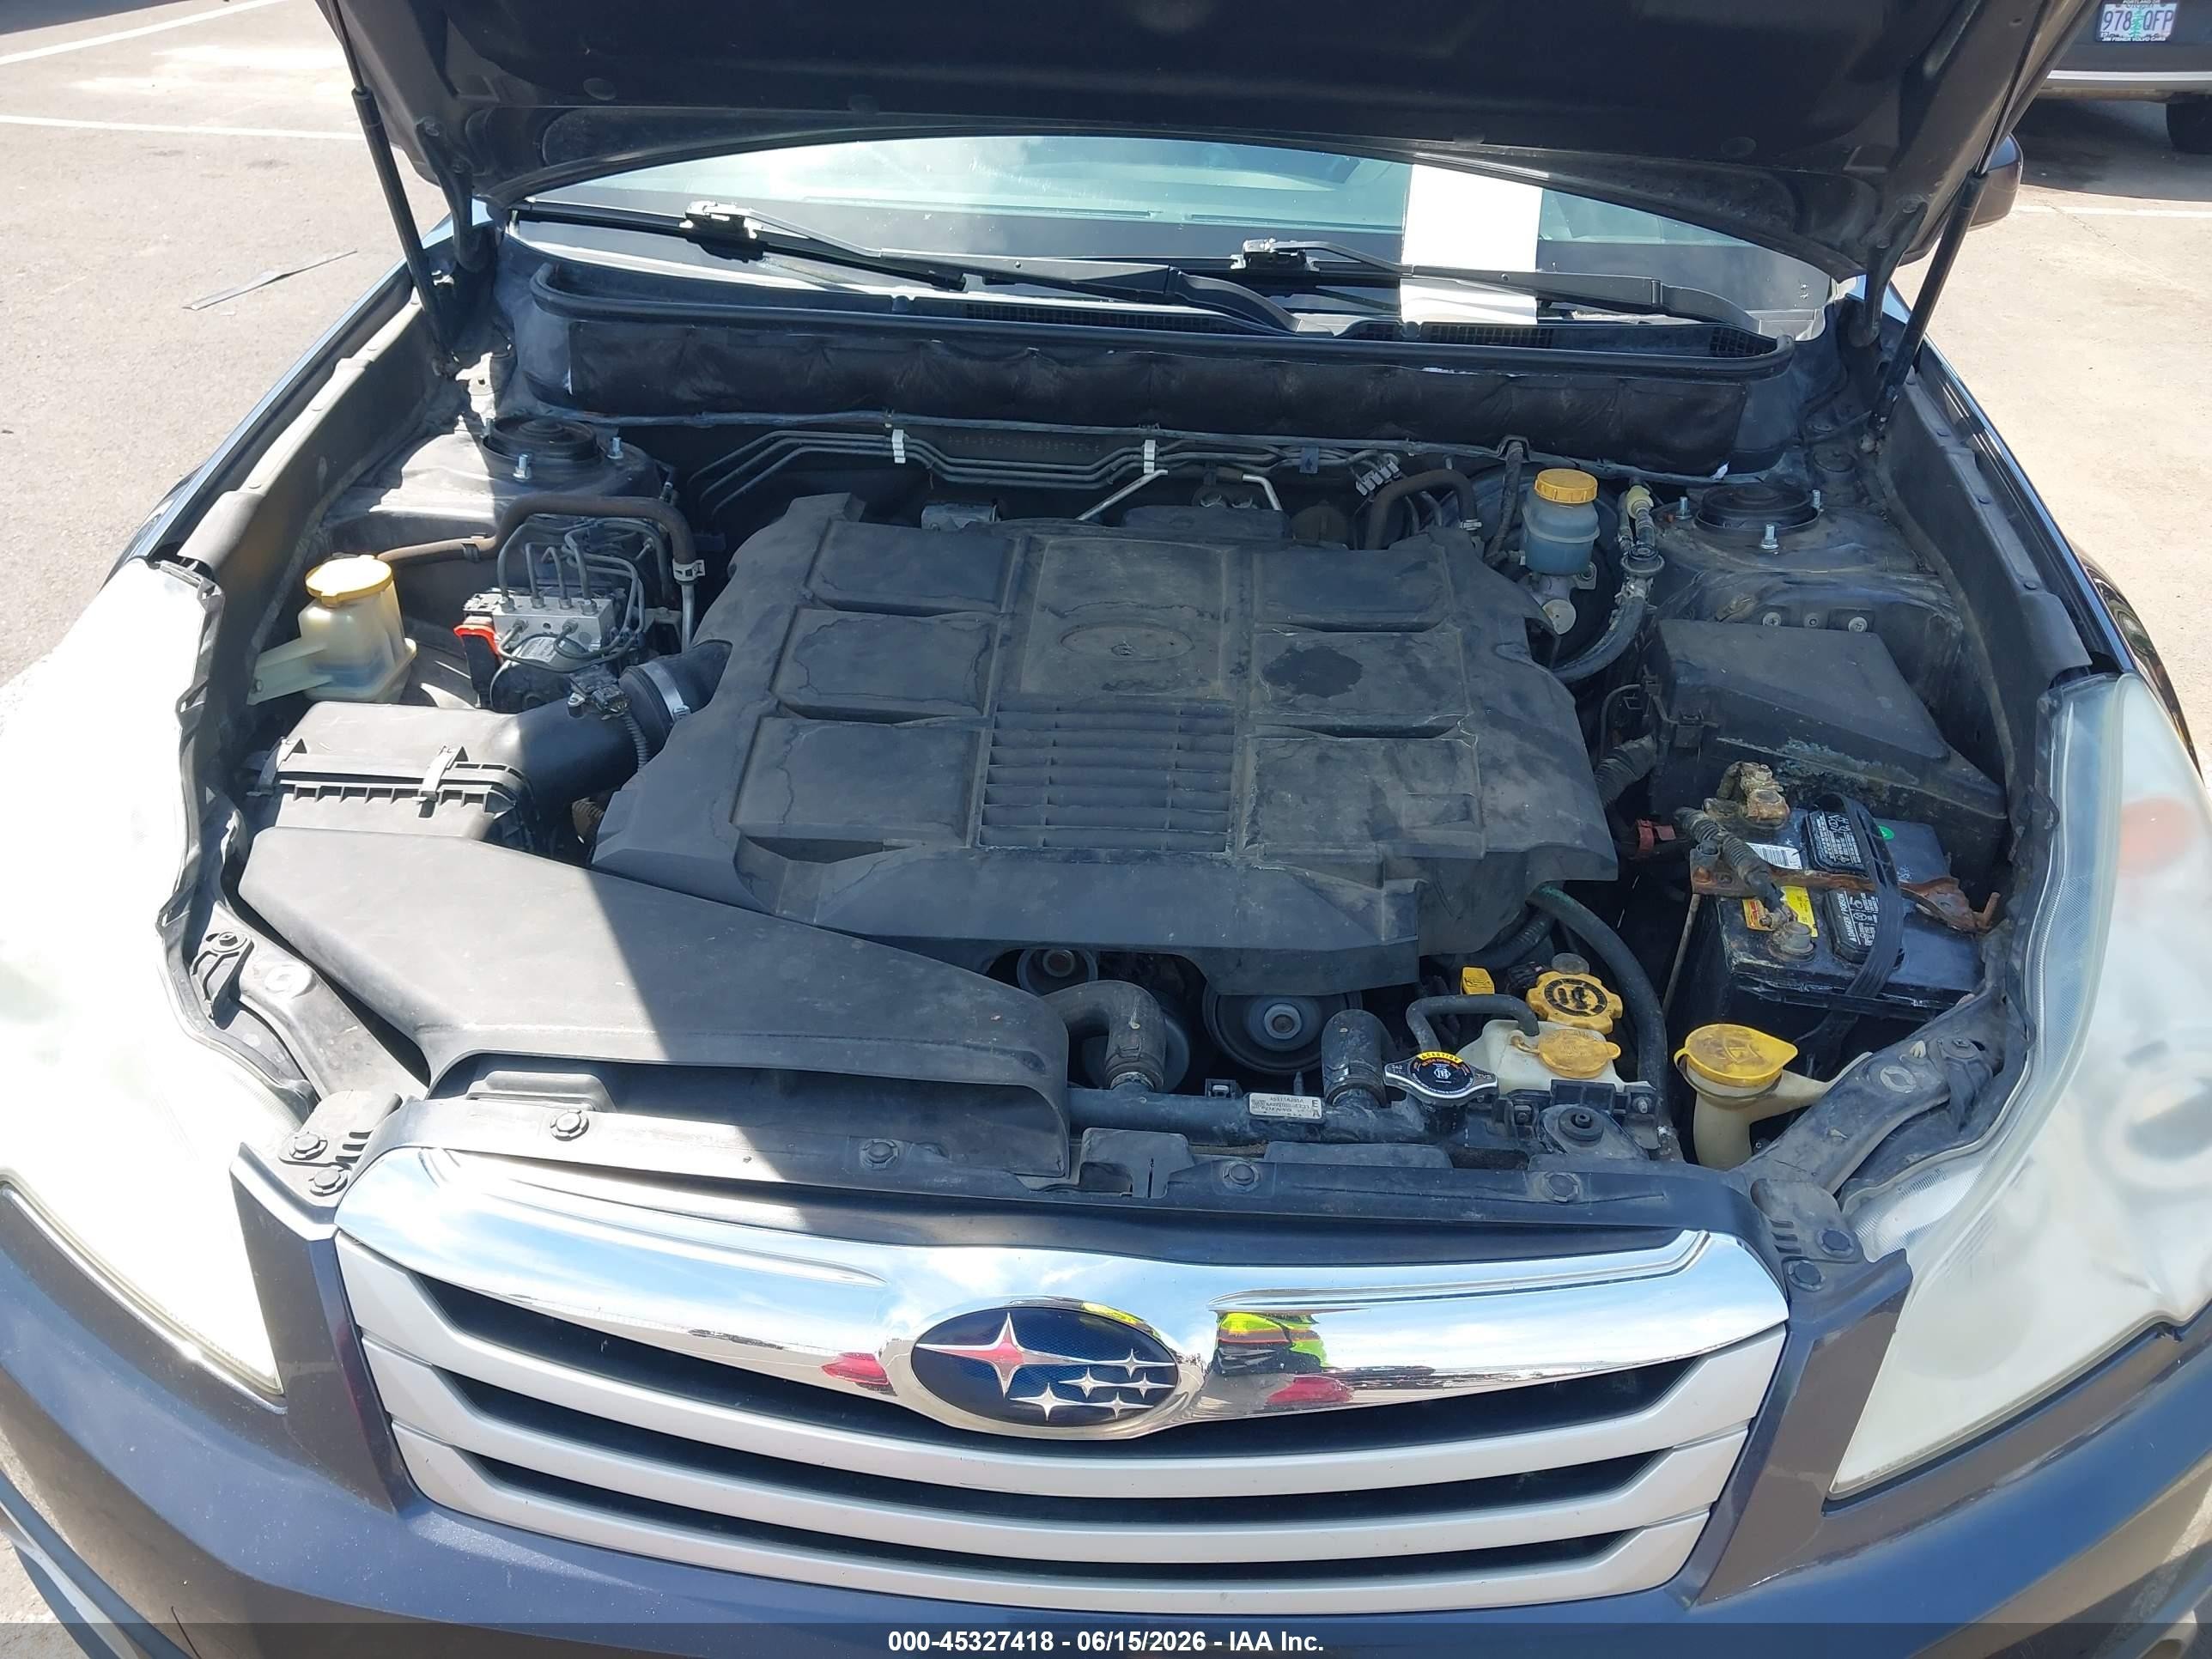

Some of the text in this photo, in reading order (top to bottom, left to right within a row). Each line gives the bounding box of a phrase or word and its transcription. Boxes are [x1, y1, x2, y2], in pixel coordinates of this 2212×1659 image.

[2103, 10, 2175, 31] 978 QFP
[1425, 1052, 1459, 1061] CAUTION
